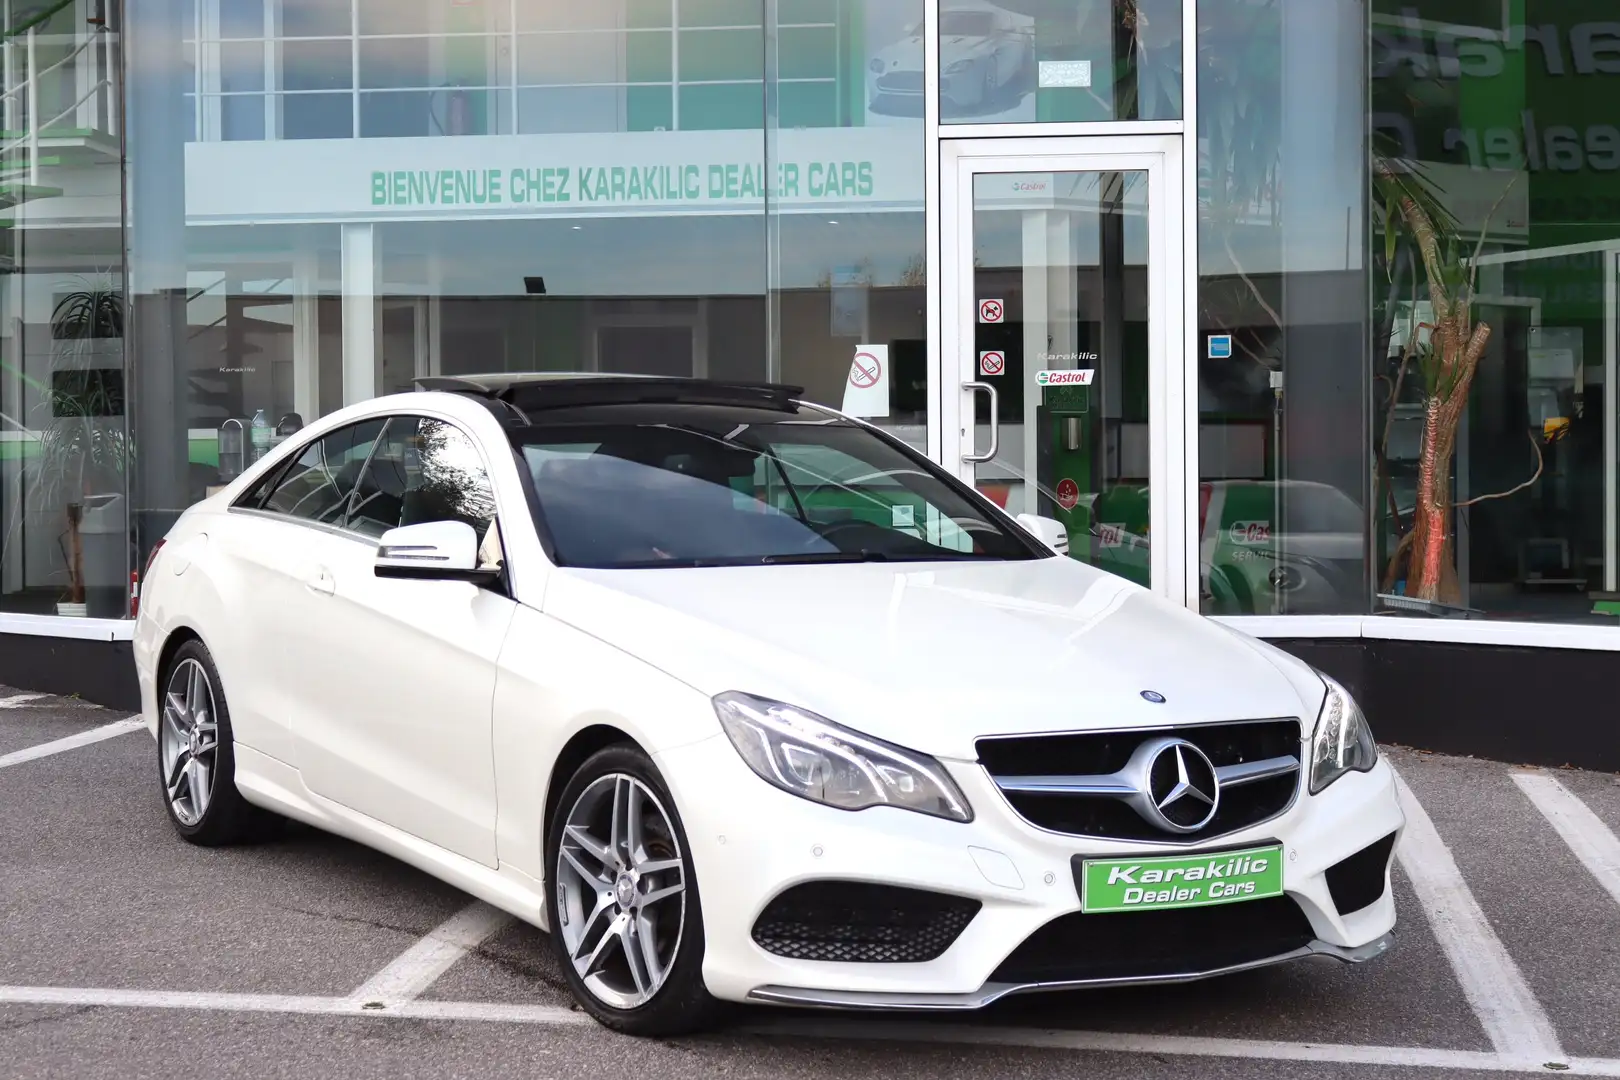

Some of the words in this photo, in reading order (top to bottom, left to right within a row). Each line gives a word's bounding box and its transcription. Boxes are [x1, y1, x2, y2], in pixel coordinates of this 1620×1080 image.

[370, 169, 502, 205] BIENVENUE
[510, 167, 571, 202] CHEZ
[578, 165, 700, 202] KARAKILIC
[708, 163, 799, 199] DEALER
[807, 161, 873, 197] CARS
[1020, 182, 1046, 191] Castrol
[1036, 352, 1098, 361] Karakilic
[1049, 372, 1086, 384] Castrol
[1107, 856, 1268, 886] Karakilic
[1122, 885, 1201, 905] Dealer
[1208, 880, 1256, 898] Cars
